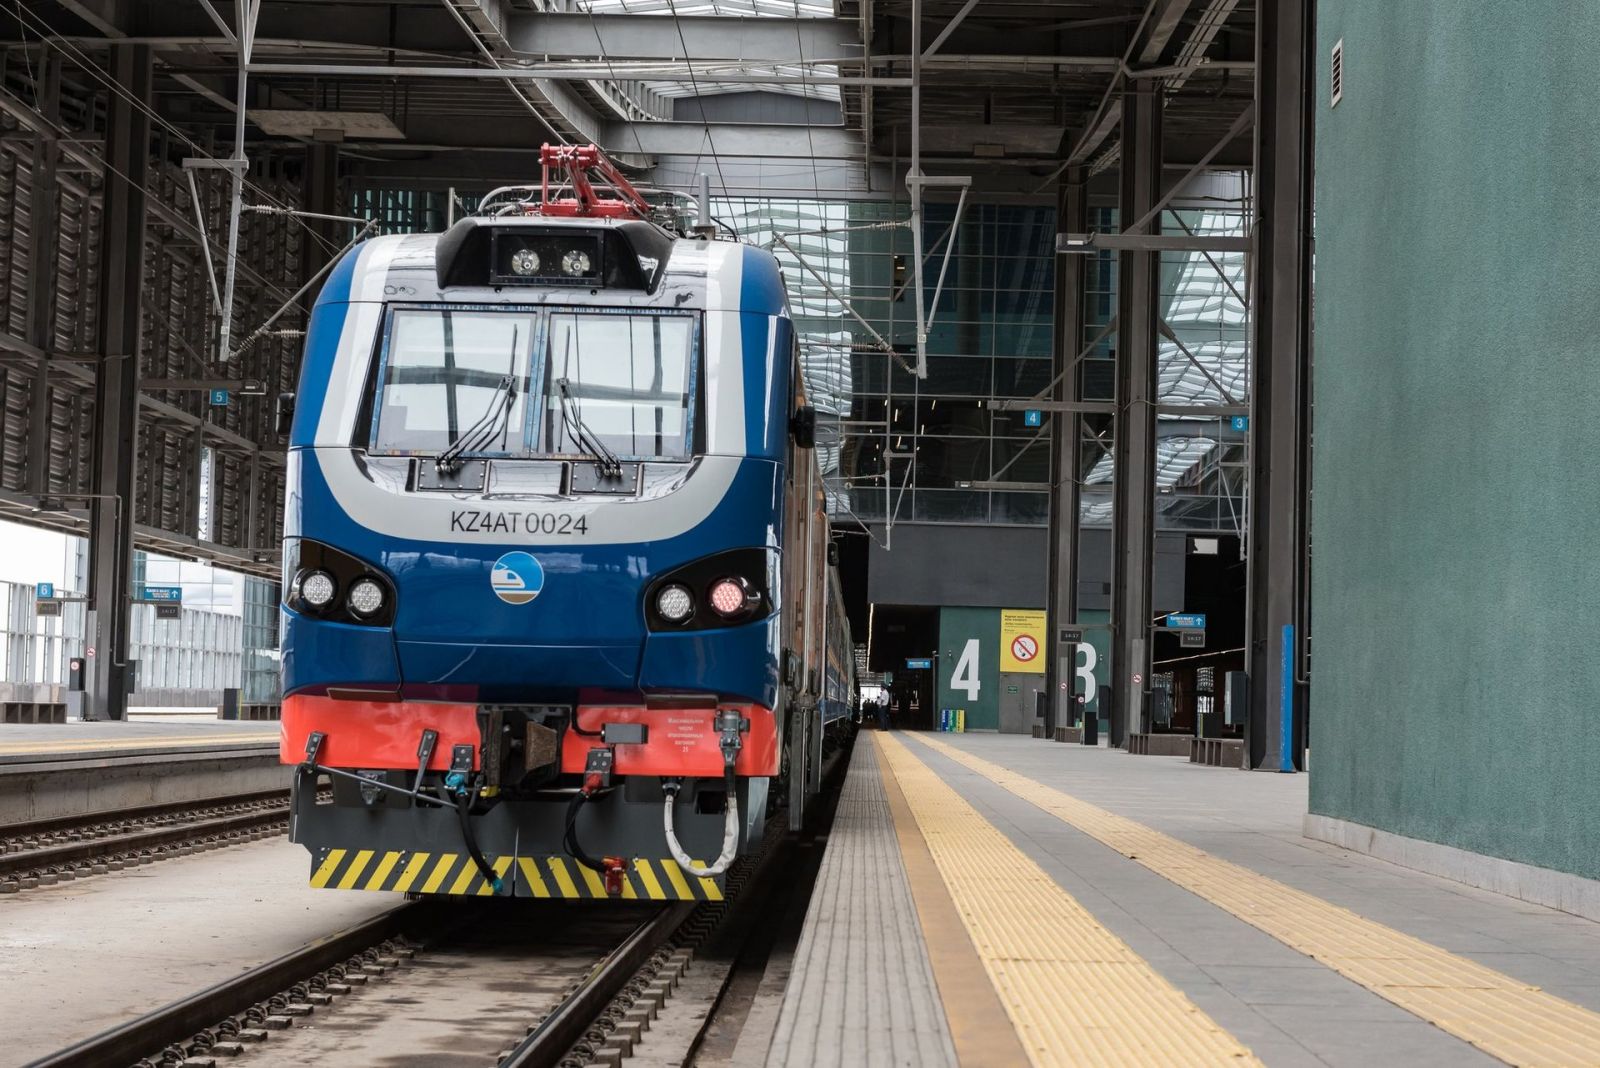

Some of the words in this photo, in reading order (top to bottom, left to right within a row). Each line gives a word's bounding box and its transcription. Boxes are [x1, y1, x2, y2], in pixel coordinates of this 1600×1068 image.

[216, 392, 223, 402] 5
[1029, 412, 1036, 423] 4
[1236, 418, 1243, 428] 3
[41, 584, 48, 595] 6
[951, 639, 981, 701] 4
[1076, 642, 1097, 703] 3
